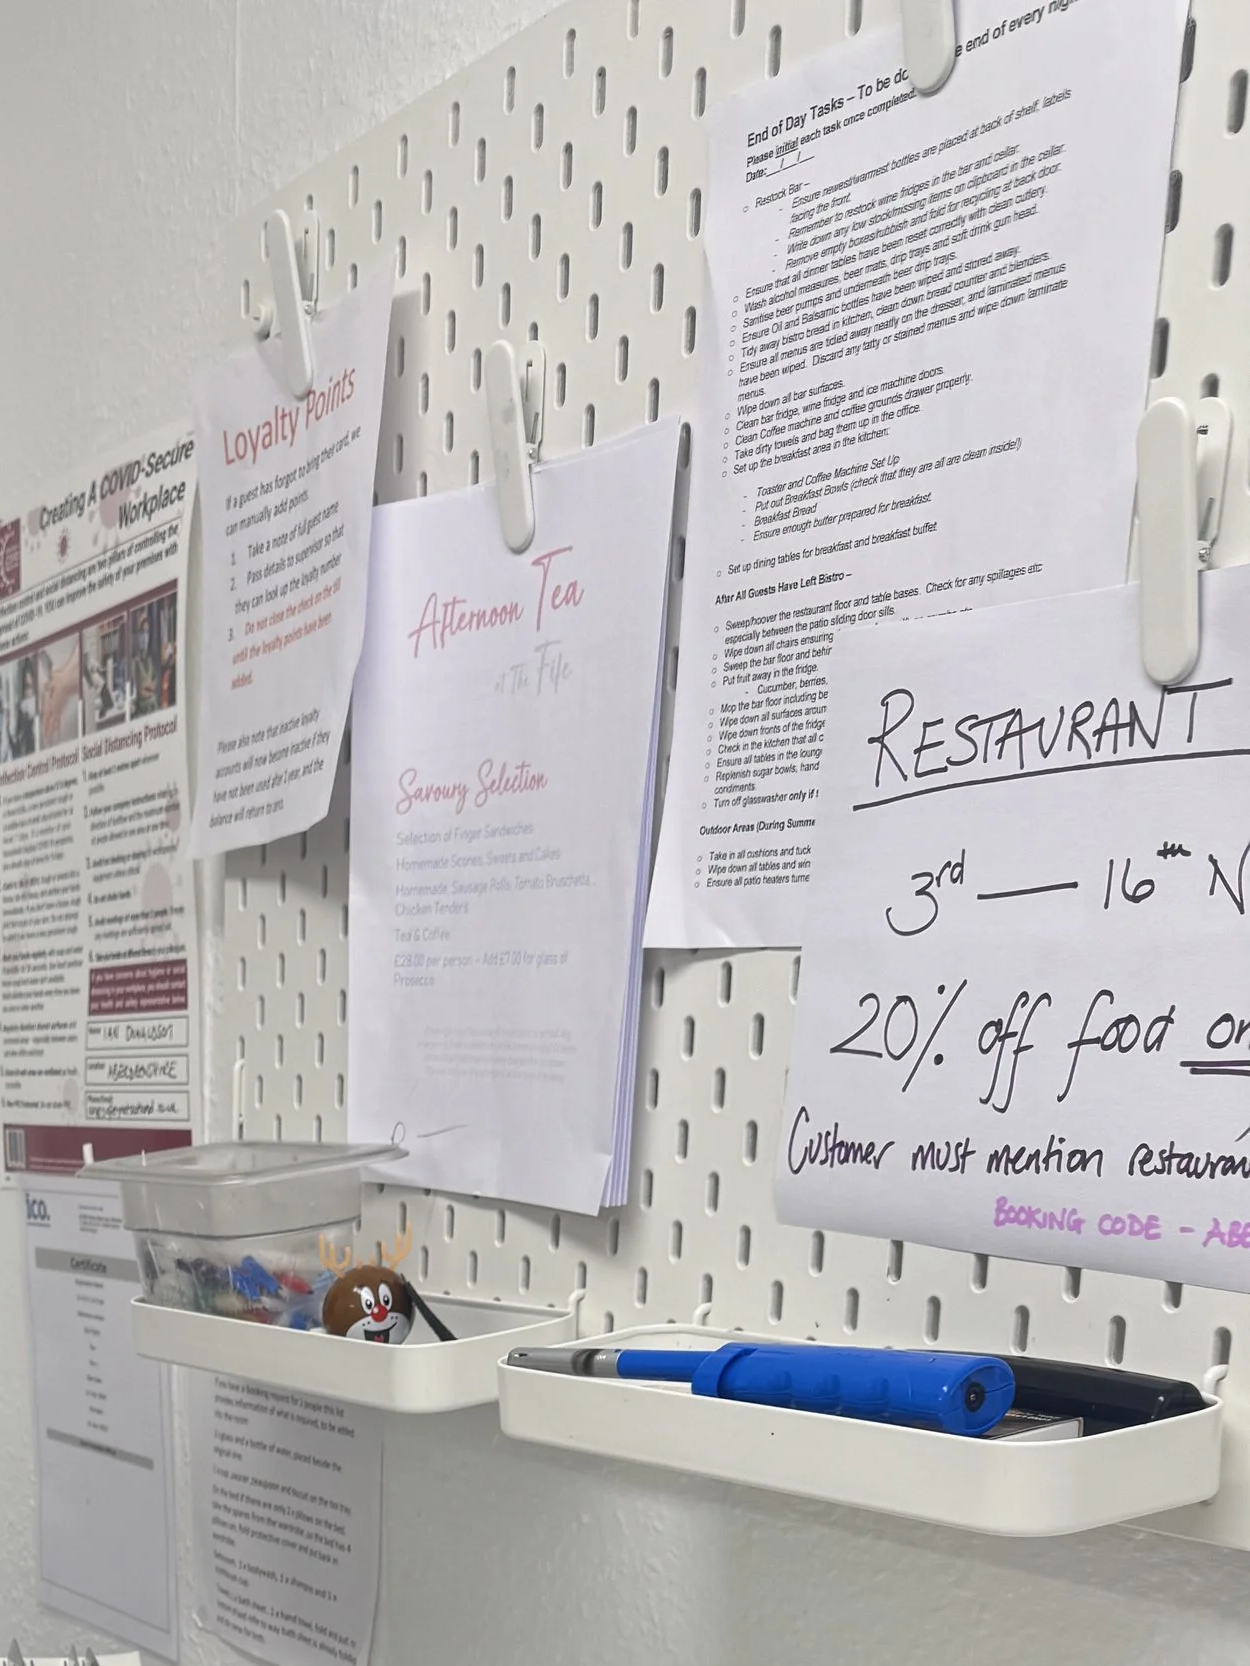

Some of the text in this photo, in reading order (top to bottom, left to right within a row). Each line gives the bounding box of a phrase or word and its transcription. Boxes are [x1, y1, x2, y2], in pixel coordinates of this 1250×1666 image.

[966, 29, 990, 52] end
[992, 21, 1007, 39] of
[1009, 6, 1045, 32] every
[748, 126, 768, 147] End
[771, 119, 783, 137] of
[786, 113, 807, 131] Day
[810, 97, 844, 120] Tasks
[857, 85, 872, 99] To
[876, 77, 890, 92] be
[747, 150, 774, 168] Please
[775, 137, 799, 156] initial
[800, 128, 821, 145] each
[823, 120, 841, 136] task
[843, 111, 865, 127] once
[755, 188, 786, 208] Restock
[788, 182, 803, 195] Bar
[223, 368, 355, 465] Loyalty Points
[736, 366, 944, 431] Clean bar fridge, wine fridge and ice machine doors.
[737, 380, 844, 416] Wipe down all bar surfaces.
[39, 440, 195, 532] Creating A COVID-Secure
[757, 454, 900, 497] Toaster and Coffee Machine Set Up
[118, 481, 186, 530] Workplace
[754, 502, 818, 527] Breakfast Bread
[728, 521, 937, 575] Set up dining tables for breakfast and breakfast buffet
[407, 545, 585, 659] Afternoon Tea
[735, 589, 746, 601] All
[748, 585, 776, 598] Guests
[778, 581, 798, 592] Have
[800, 576, 817, 588] Left
[818, 572, 844, 584] Bistro
[722, 663, 818, 686] Put fruit away in the fridge.
[82, 714, 178, 762] Social Distancing Protocol
[868, 678, 1233, 787] RESTAURANT
[51, 750, 80, 771] Protocol
[715, 761, 820, 782] Replenish sugar bowls, hand
[395, 758, 549, 815] Savoury Selection
[699, 825, 732, 835] Outdoor
[732, 823, 755, 833] Areas
[756, 820, 785, 833] (During
[710, 844, 811, 861] Take in all cushions and tuck
[885, 849, 966, 936] 3rd
[1103, 841, 1192, 909] 16th
[394, 928, 412, 942] Tea
[830, 979, 967, 1093] 20%
[978, 991, 1052, 1113] off
[1057, 989, 1176, 1102] food
[788, 1106, 895, 1175] Customer
[911, 1136, 977, 1175] must
[986, 1134, 1103, 1178] mention
[993, 1196, 1086, 1236] BOOKING
[1098, 1214, 1162, 1241] CODE
[70, 1256, 108, 1275] Certificate
